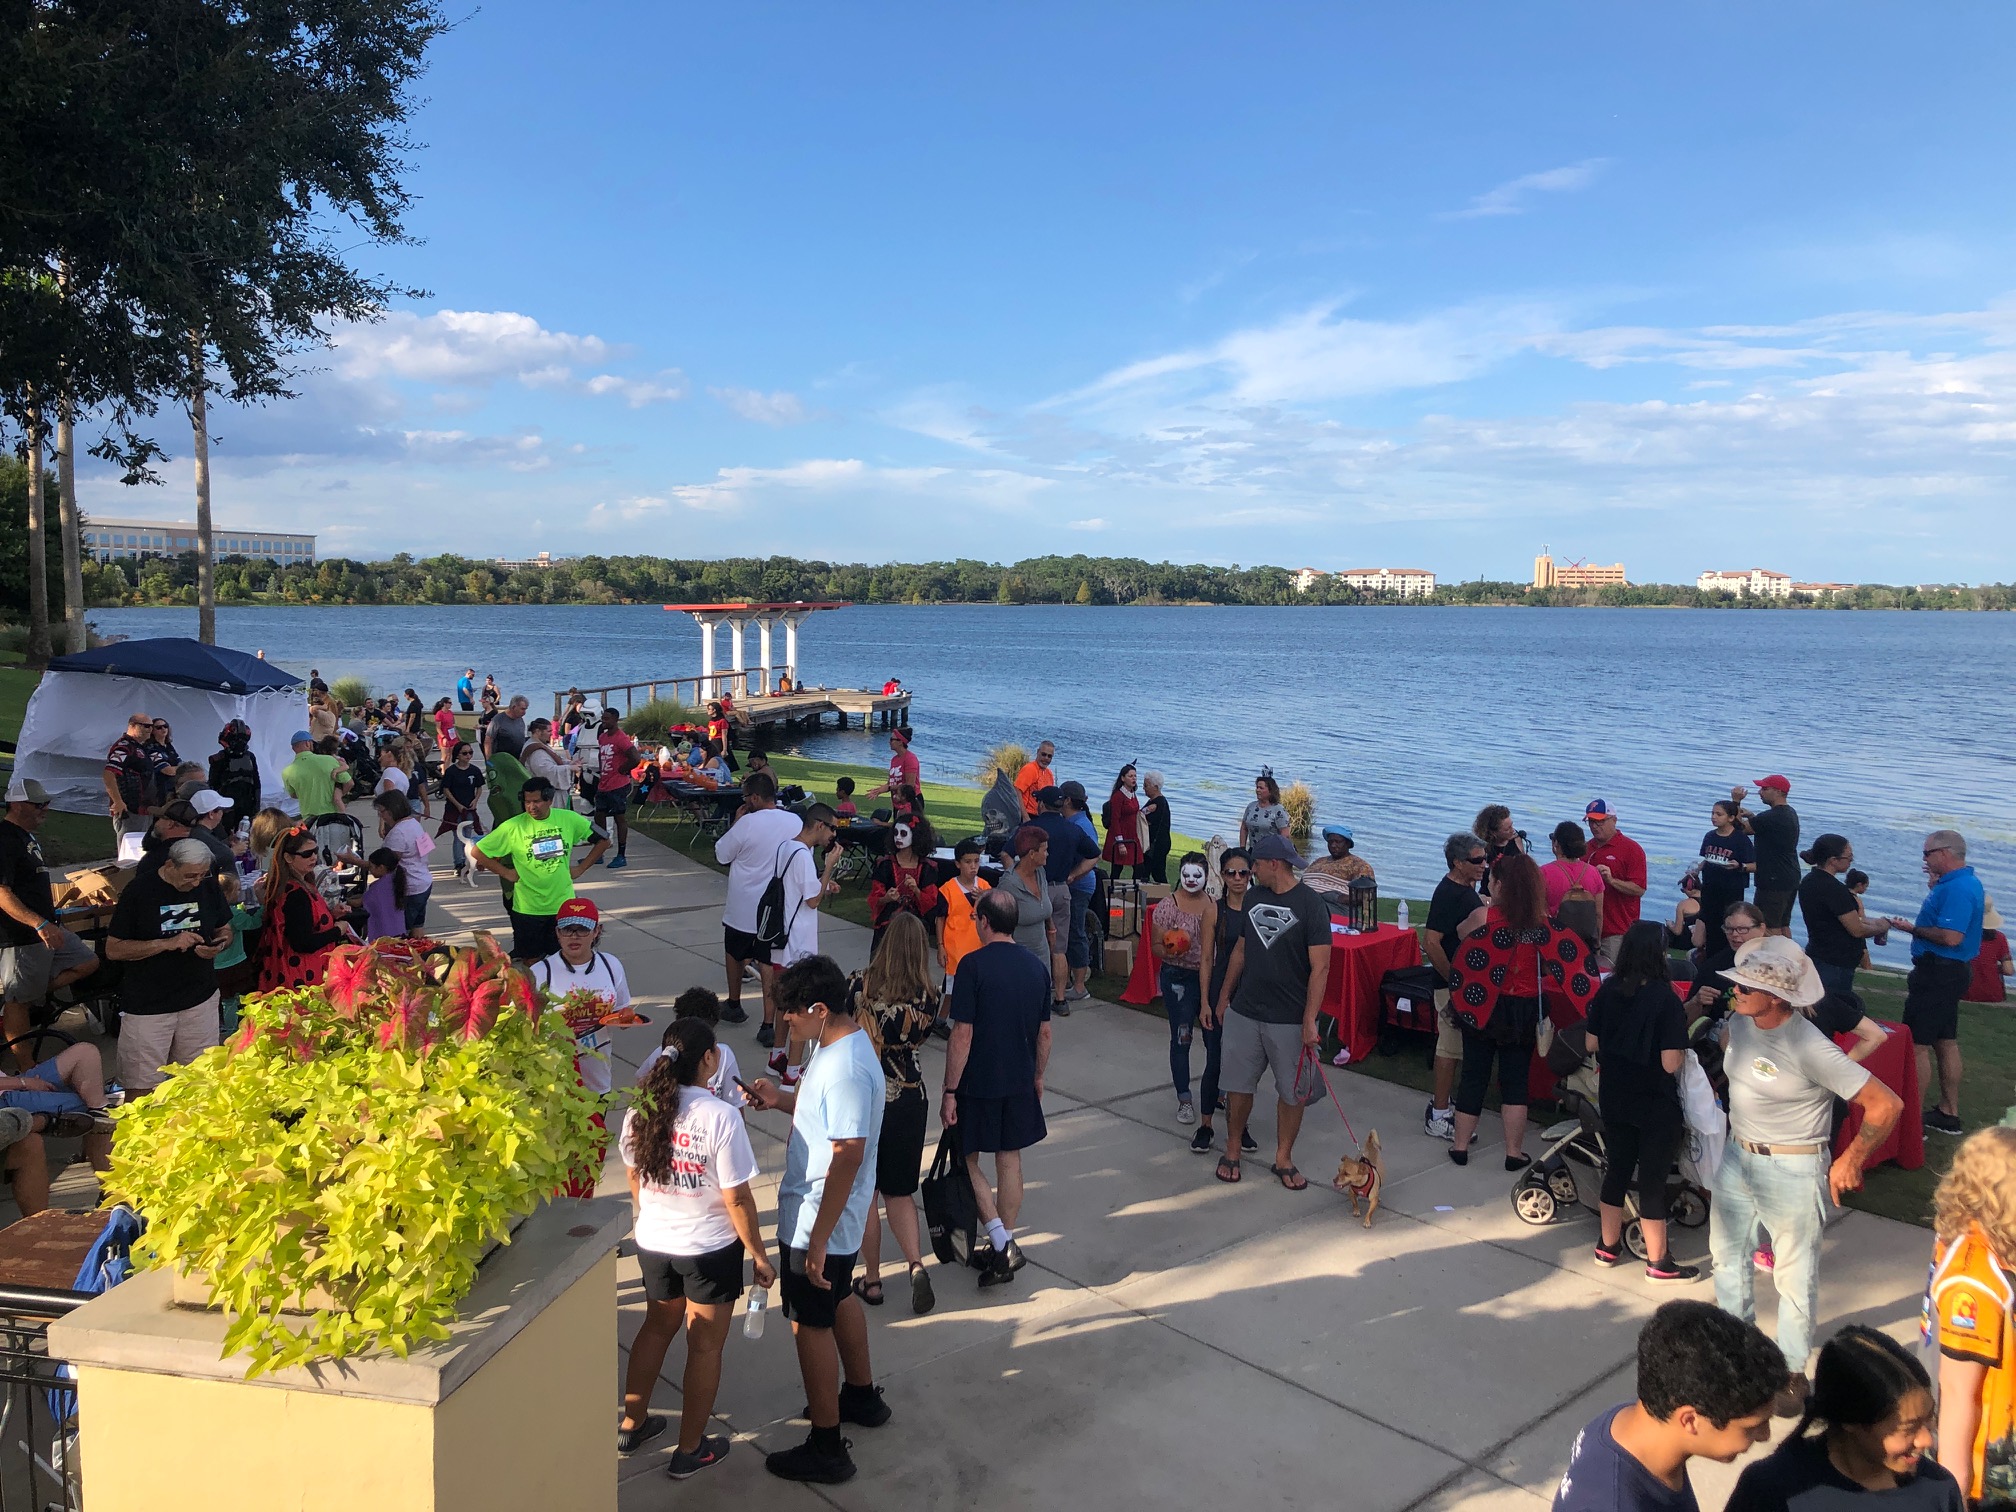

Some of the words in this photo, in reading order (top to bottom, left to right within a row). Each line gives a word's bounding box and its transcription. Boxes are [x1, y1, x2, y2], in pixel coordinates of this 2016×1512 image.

[538, 840, 558, 853] 568
[691, 1132, 706, 1143] WE
[676, 1149, 707, 1164] strong
[673, 1172, 712, 1190] HAVE.
